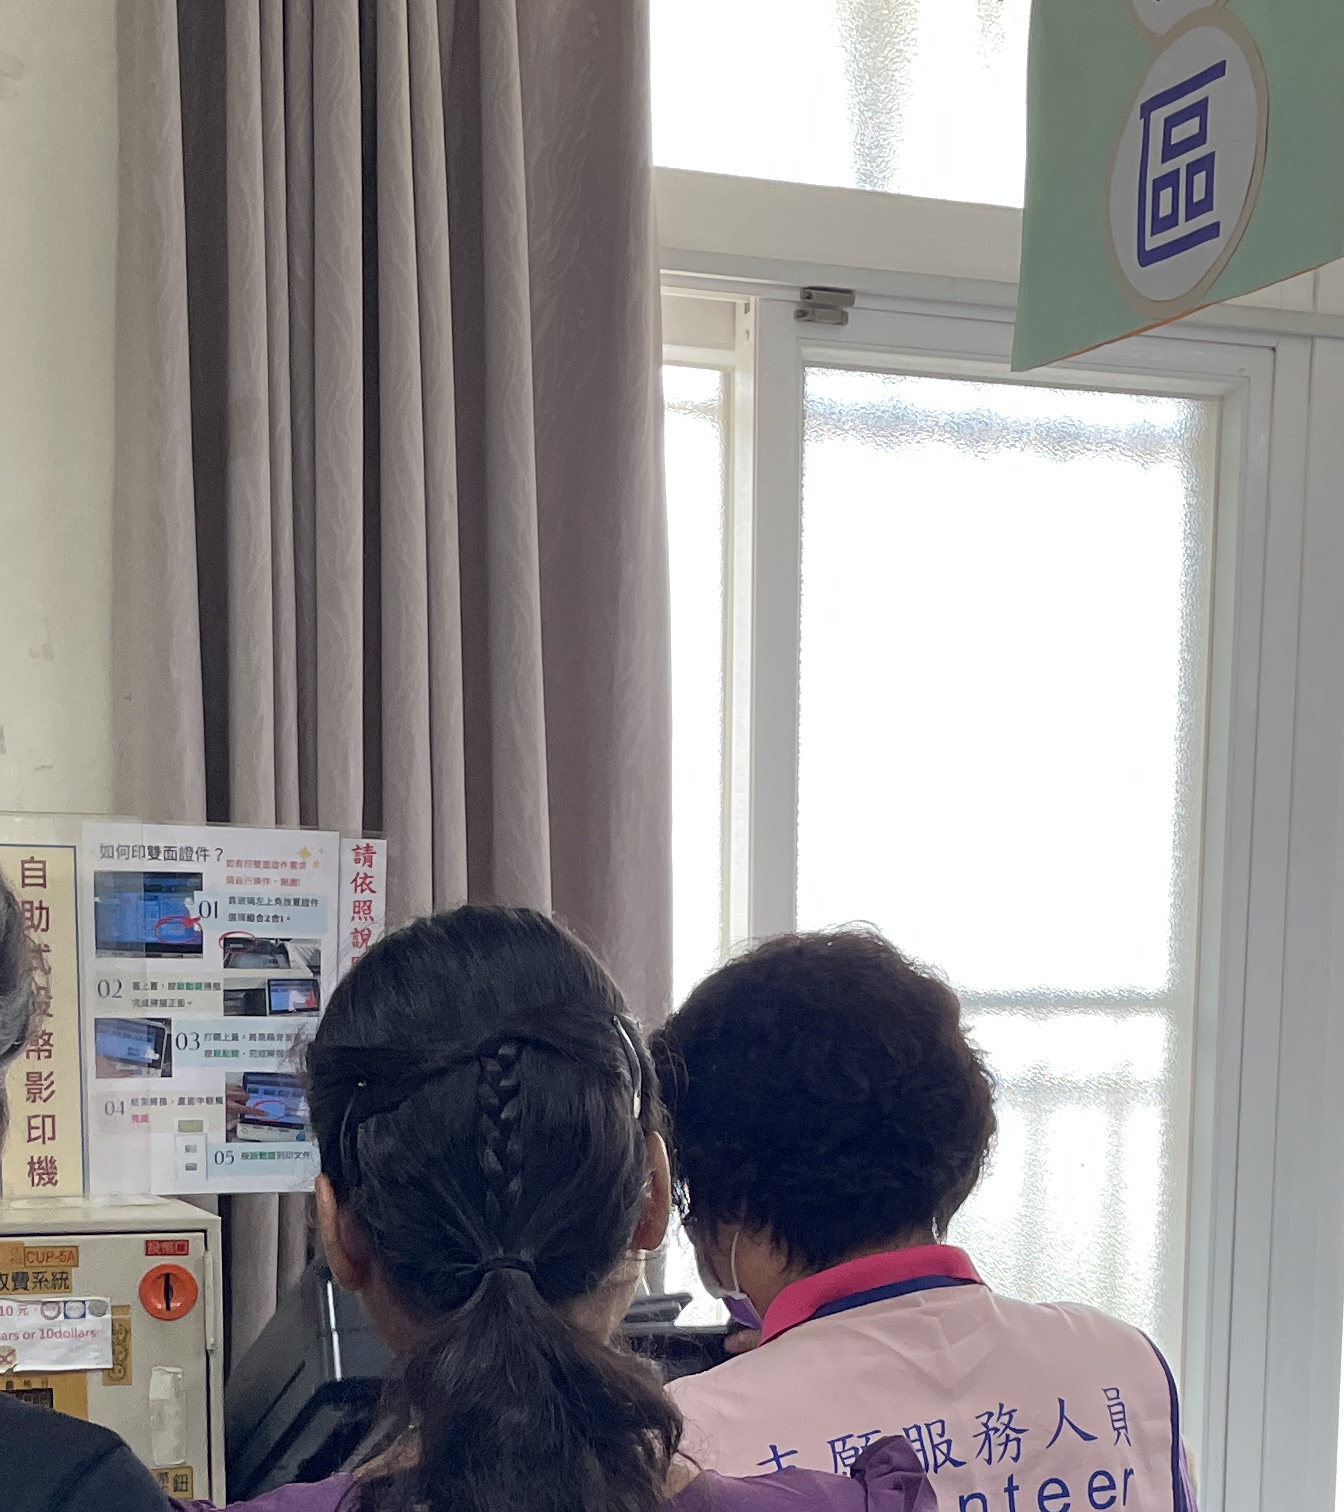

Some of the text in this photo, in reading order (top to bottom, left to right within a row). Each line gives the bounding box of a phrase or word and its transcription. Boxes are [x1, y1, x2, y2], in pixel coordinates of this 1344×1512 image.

[1137, 59, 1226, 267] 區
[99, 843, 224, 863] 如何印雙面證件？
[198, 899, 219, 919] 01
[97, 979, 123, 999] 02
[175, 1031, 201, 1052] 03
[104, 1100, 126, 1116] 04
[214, 1149, 235, 1166] 05
